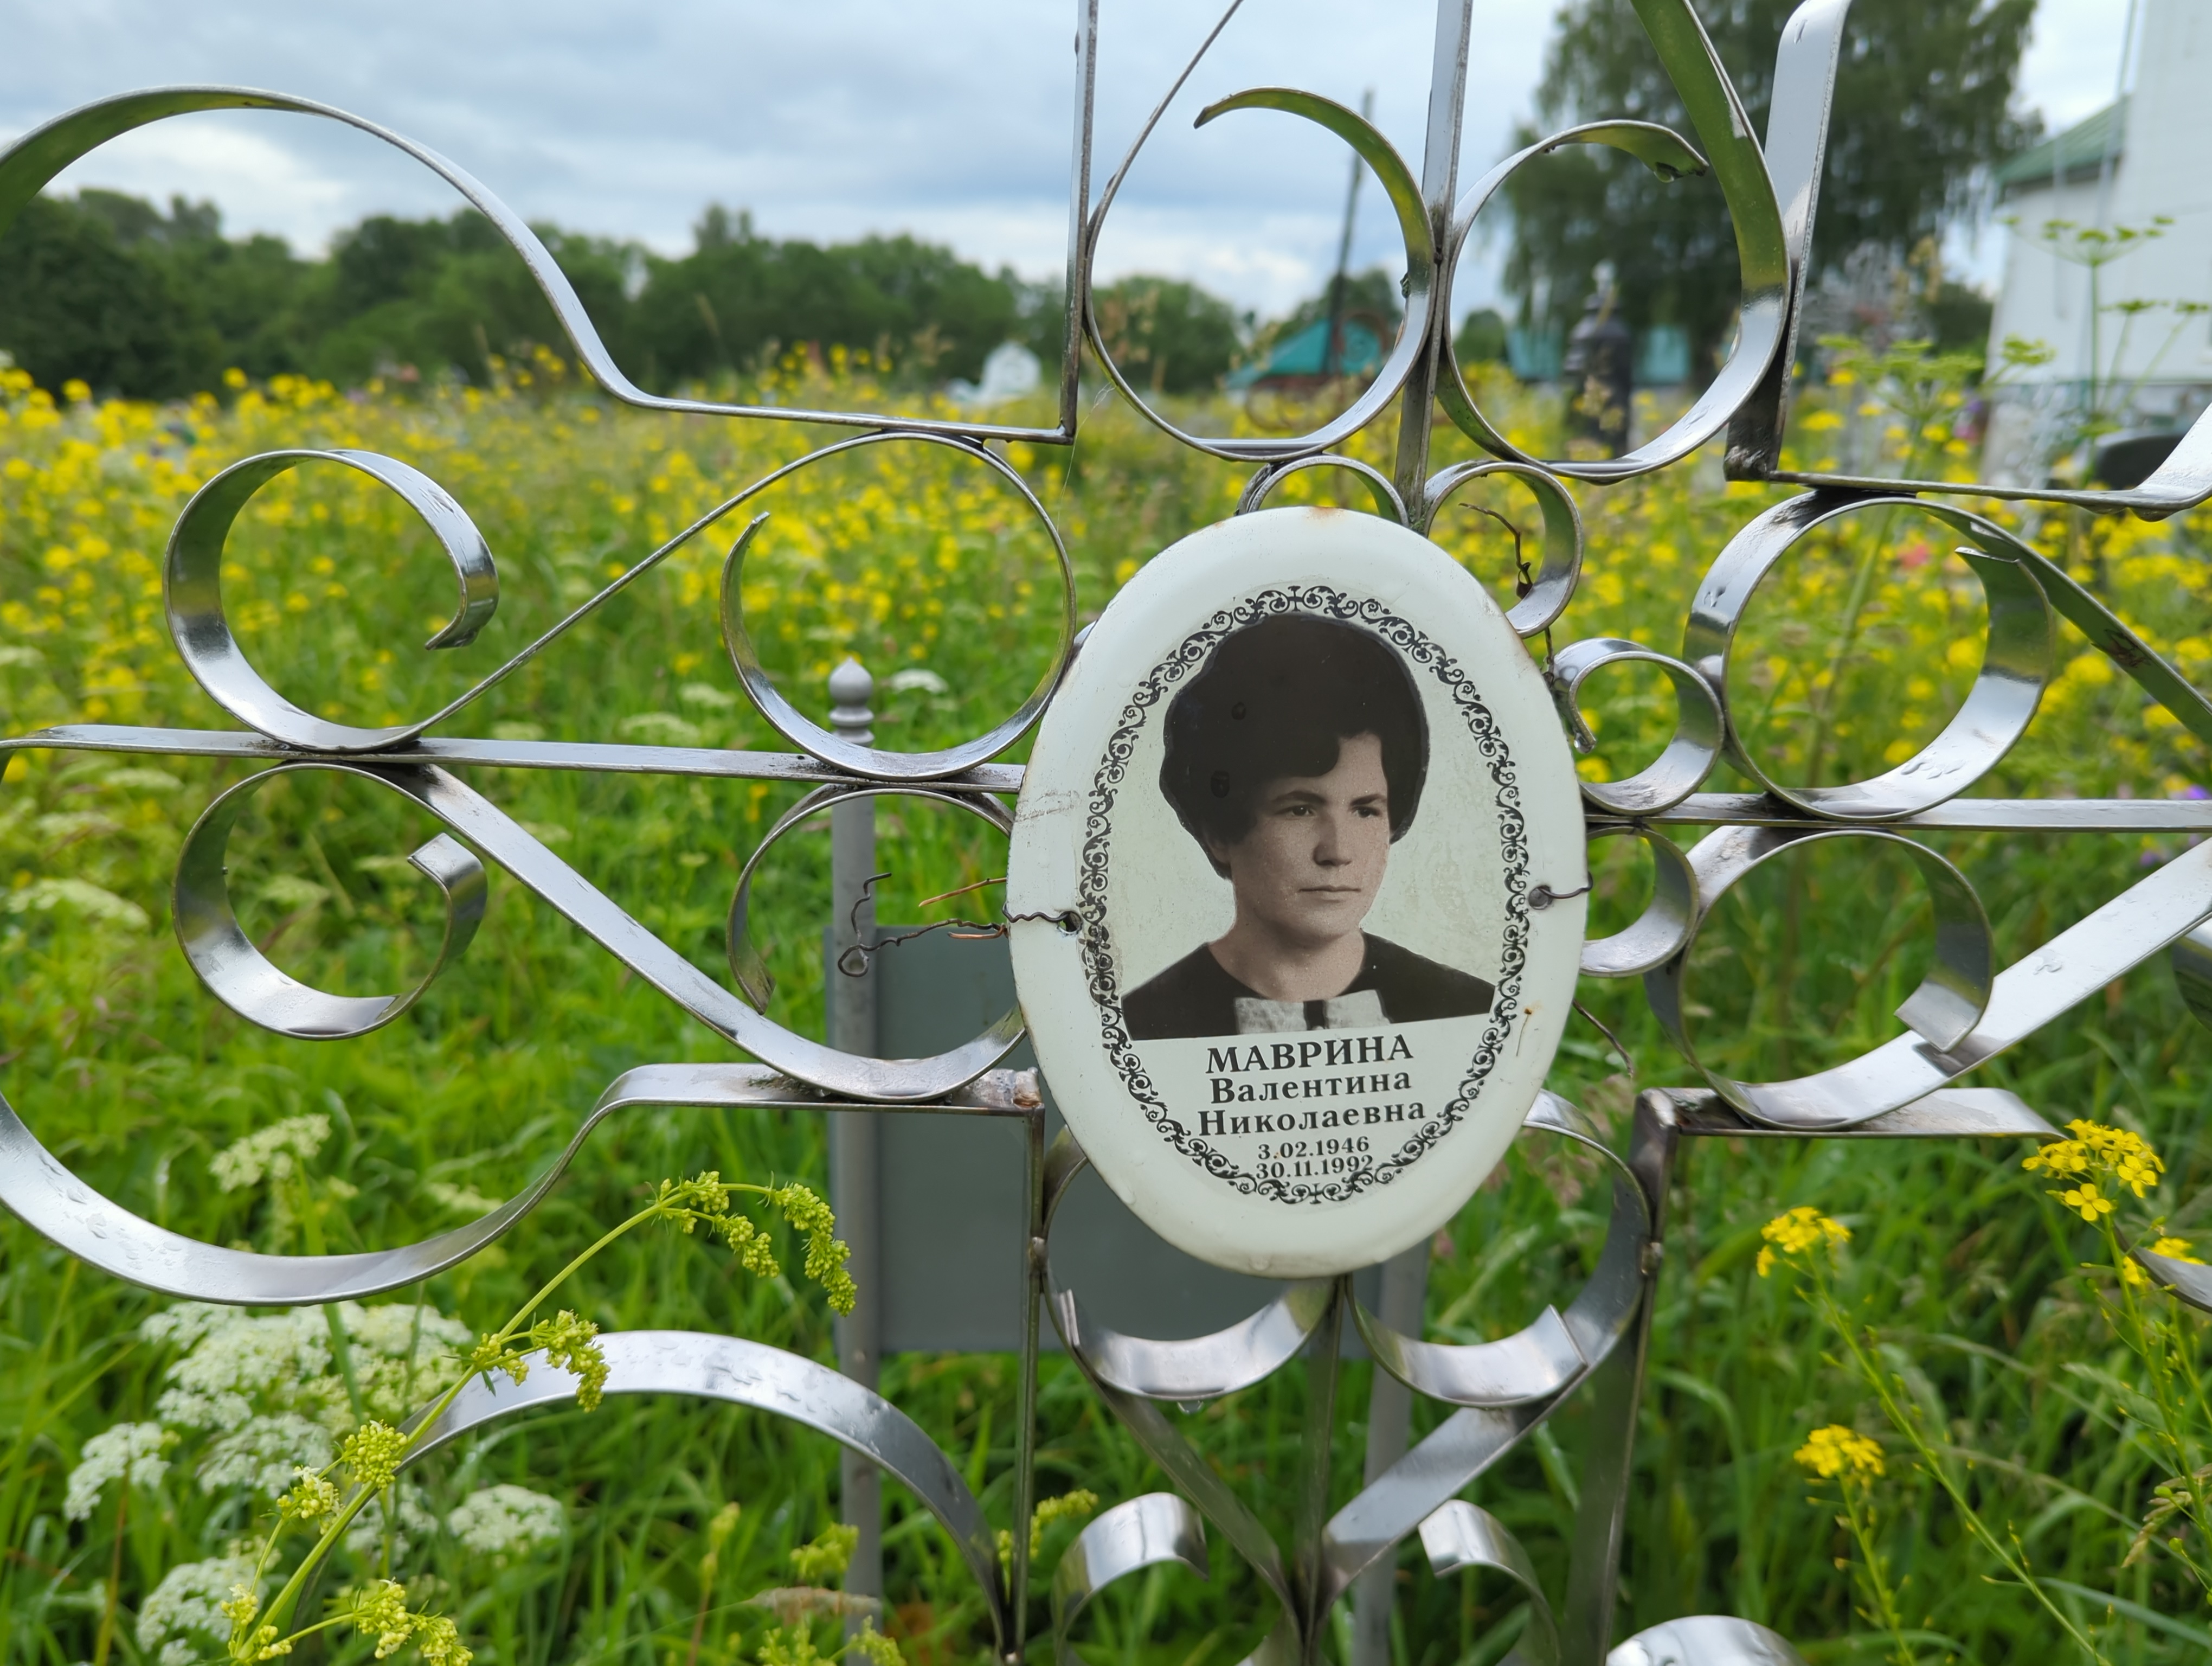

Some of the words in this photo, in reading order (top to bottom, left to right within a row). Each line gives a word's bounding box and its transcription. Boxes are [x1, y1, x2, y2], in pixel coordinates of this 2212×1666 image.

[1205, 1034, 1414, 1074] МАВРИНА
[1210, 1071, 1412, 1104] Валентина
[1197, 1101, 1426, 1136] Николаевна
[1258, 1136, 1369, 1160] 3.02.1946
[1256, 1155, 1373, 1180] 30.11.1992
